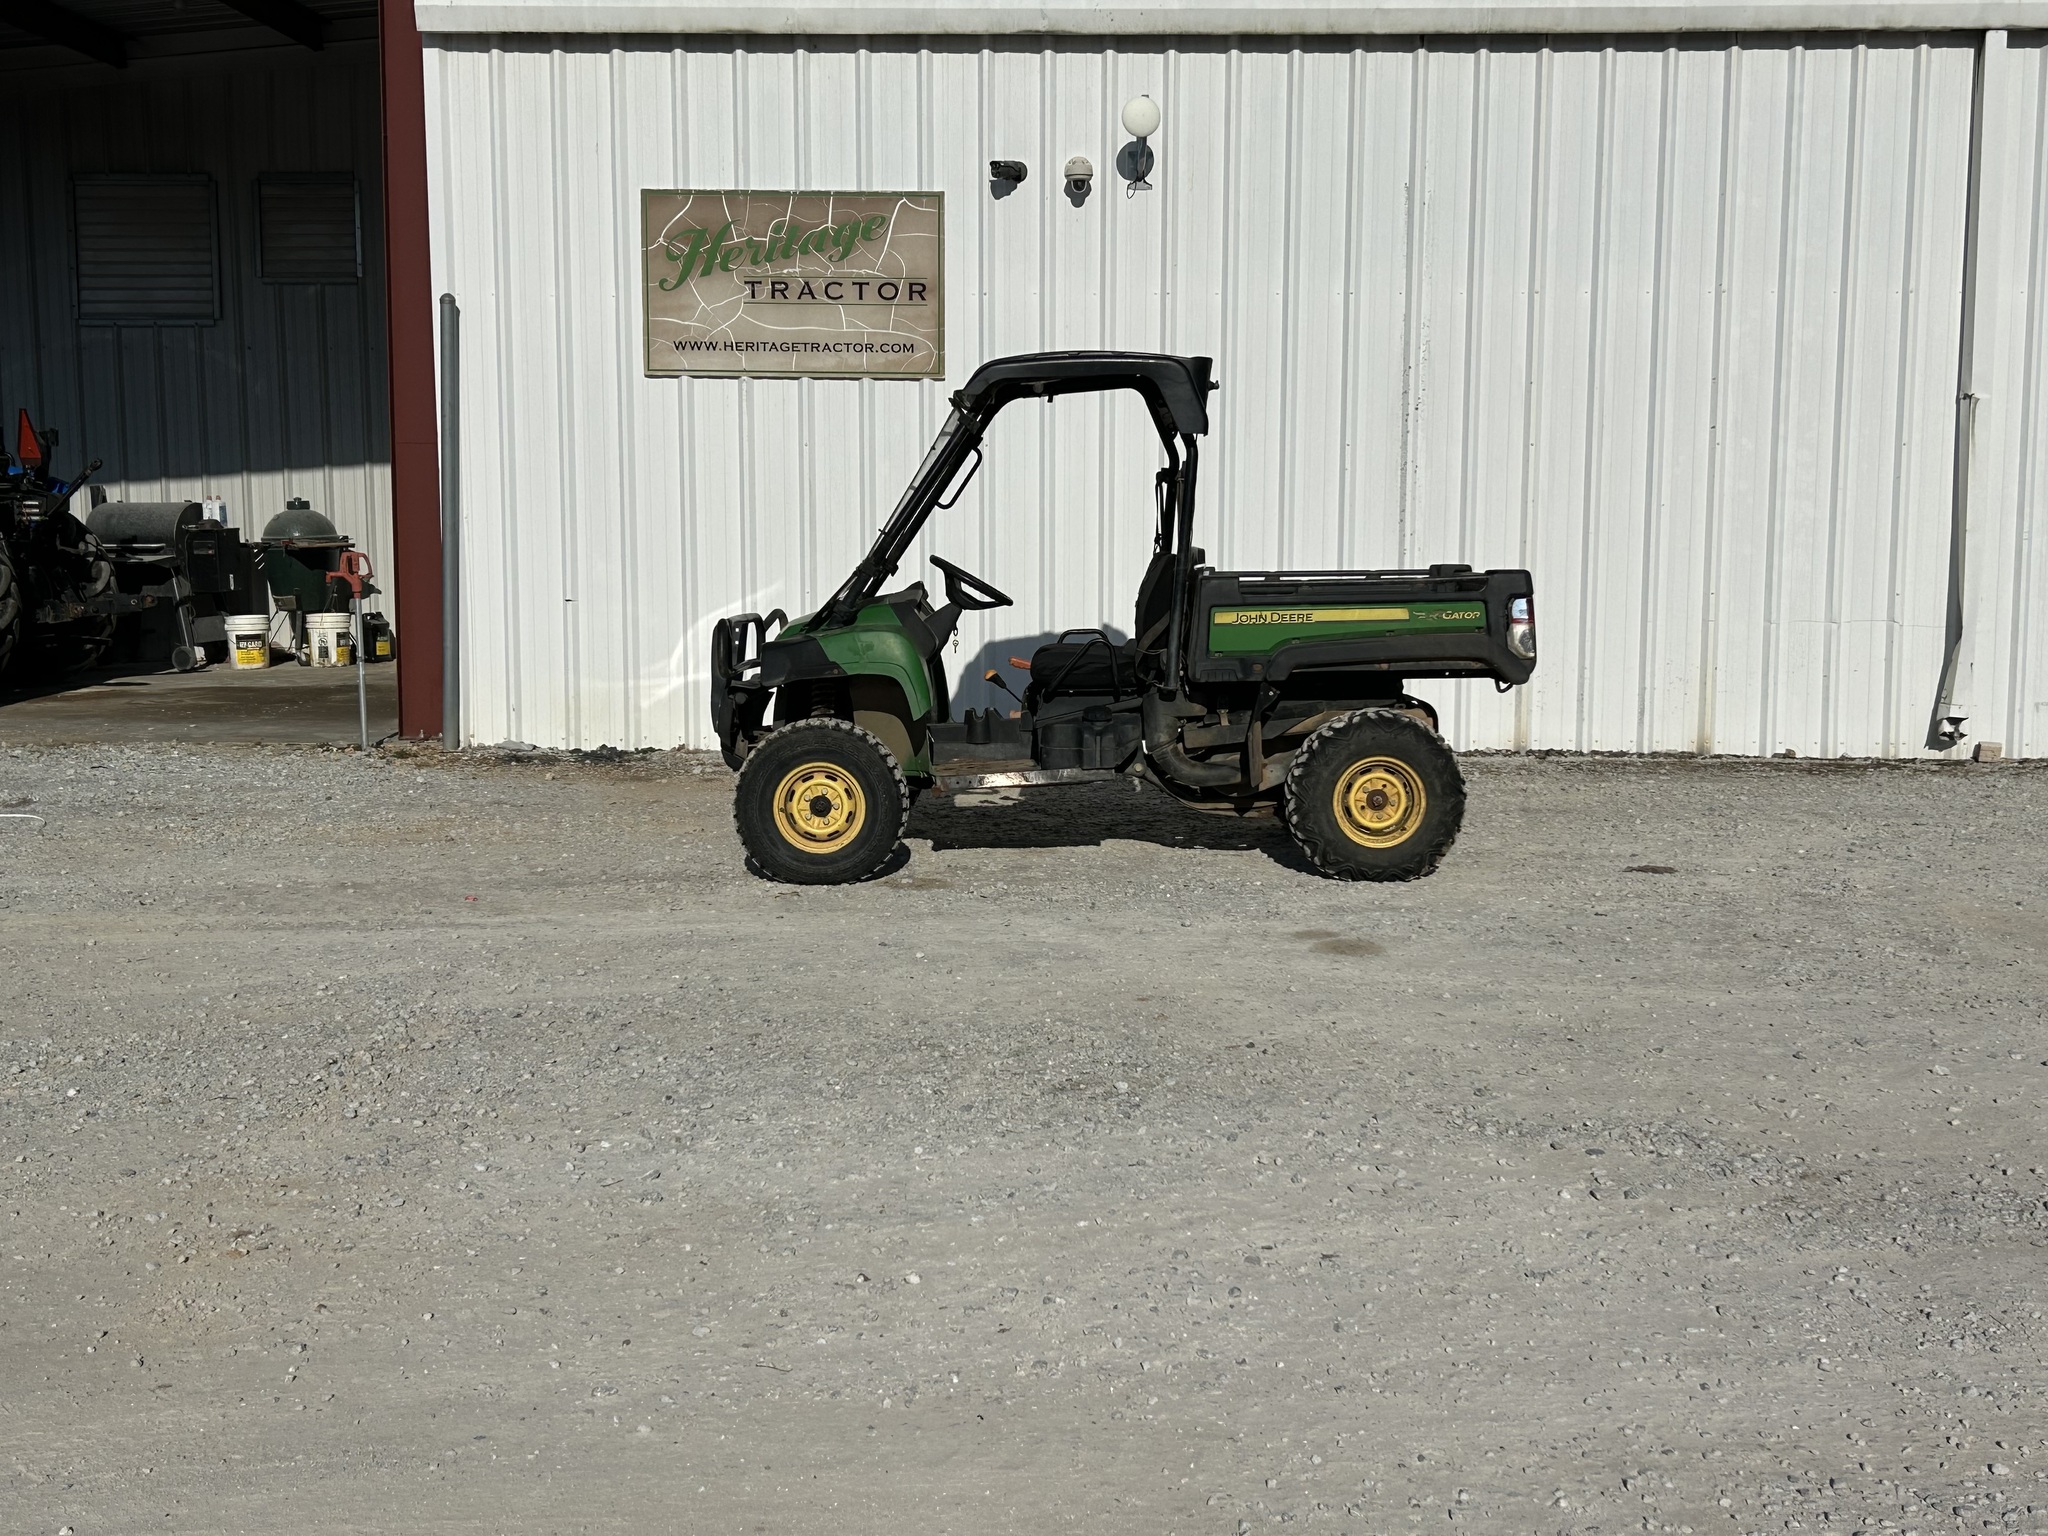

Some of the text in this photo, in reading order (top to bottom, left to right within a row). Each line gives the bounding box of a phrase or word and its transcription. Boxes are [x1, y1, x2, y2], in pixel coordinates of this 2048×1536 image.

[658, 213, 890, 292] Heritage
[744, 280, 927, 301] TRACTOR
[673, 340, 915, 354] WWW.HERITAGETRACTOR.COM
[1232, 611, 1314, 624] JOHN DEERE
[1442, 610, 1480, 620] GATOR
